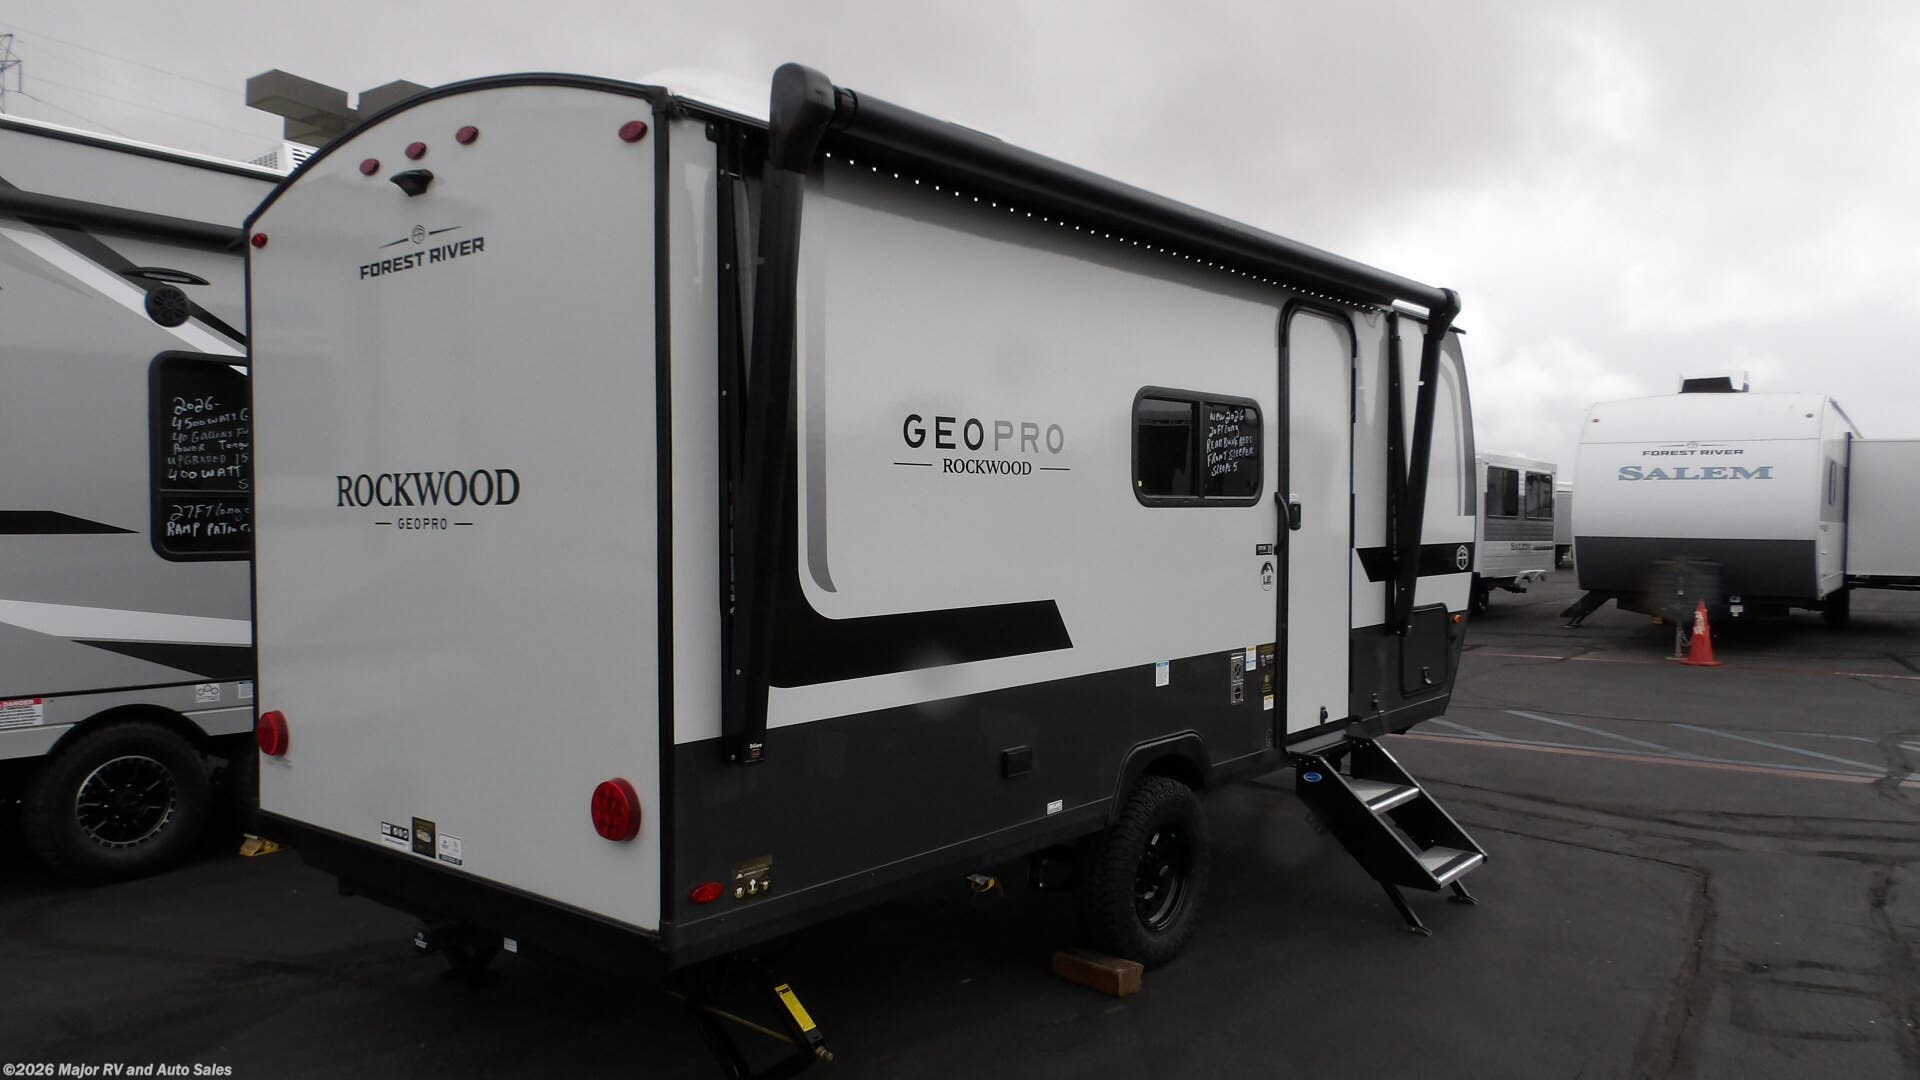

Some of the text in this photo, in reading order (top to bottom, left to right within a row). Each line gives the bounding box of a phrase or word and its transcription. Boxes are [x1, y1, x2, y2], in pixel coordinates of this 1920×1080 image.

[359, 237, 485, 280] FOREST RIVER
[943, 458, 1032, 476] ROCKWOOD
[1617, 465, 1774, 481] SALEM
[336, 468, 521, 507] ROCKWOOD
[166, 521, 200, 537] RAMP
[398, 517, 447, 530] GEOPRO
